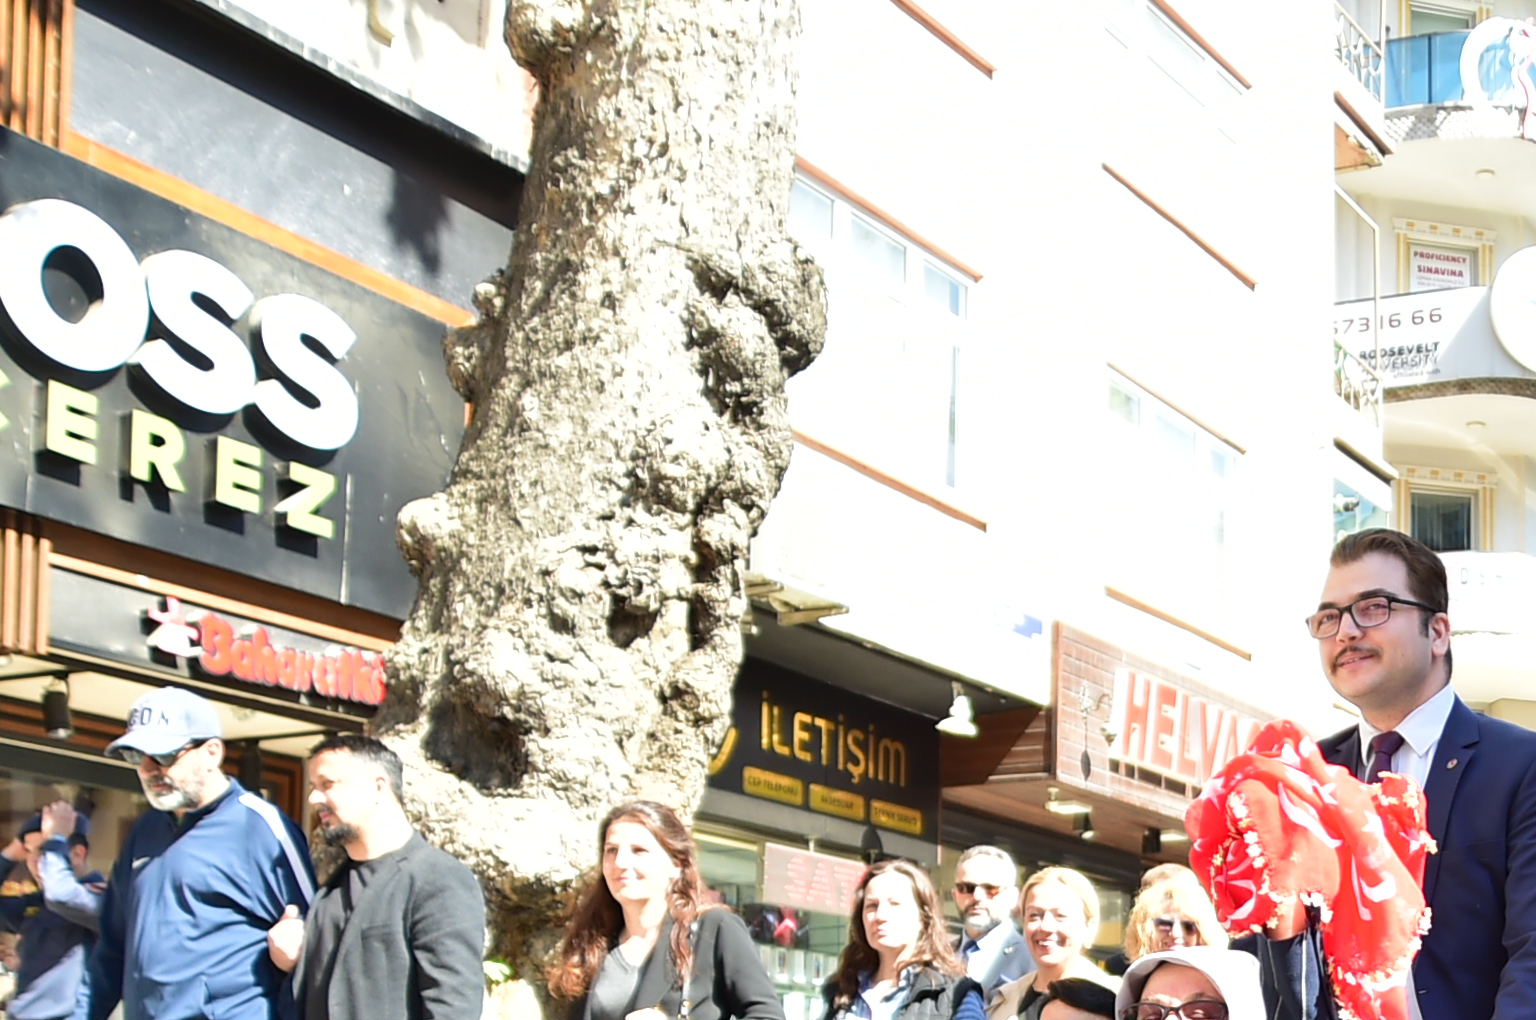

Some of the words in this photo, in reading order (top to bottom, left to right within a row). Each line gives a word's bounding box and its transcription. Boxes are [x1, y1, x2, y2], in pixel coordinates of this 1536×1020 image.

[1413, 250, 1467, 264] PROFICIENCY
[1416, 264, 1465, 278] SINAVINA
[1411, 307, 1442, 326] 66
[1359, 341, 1440, 360] ROOSEVELT
[0, 368, 338, 541] EREZ
